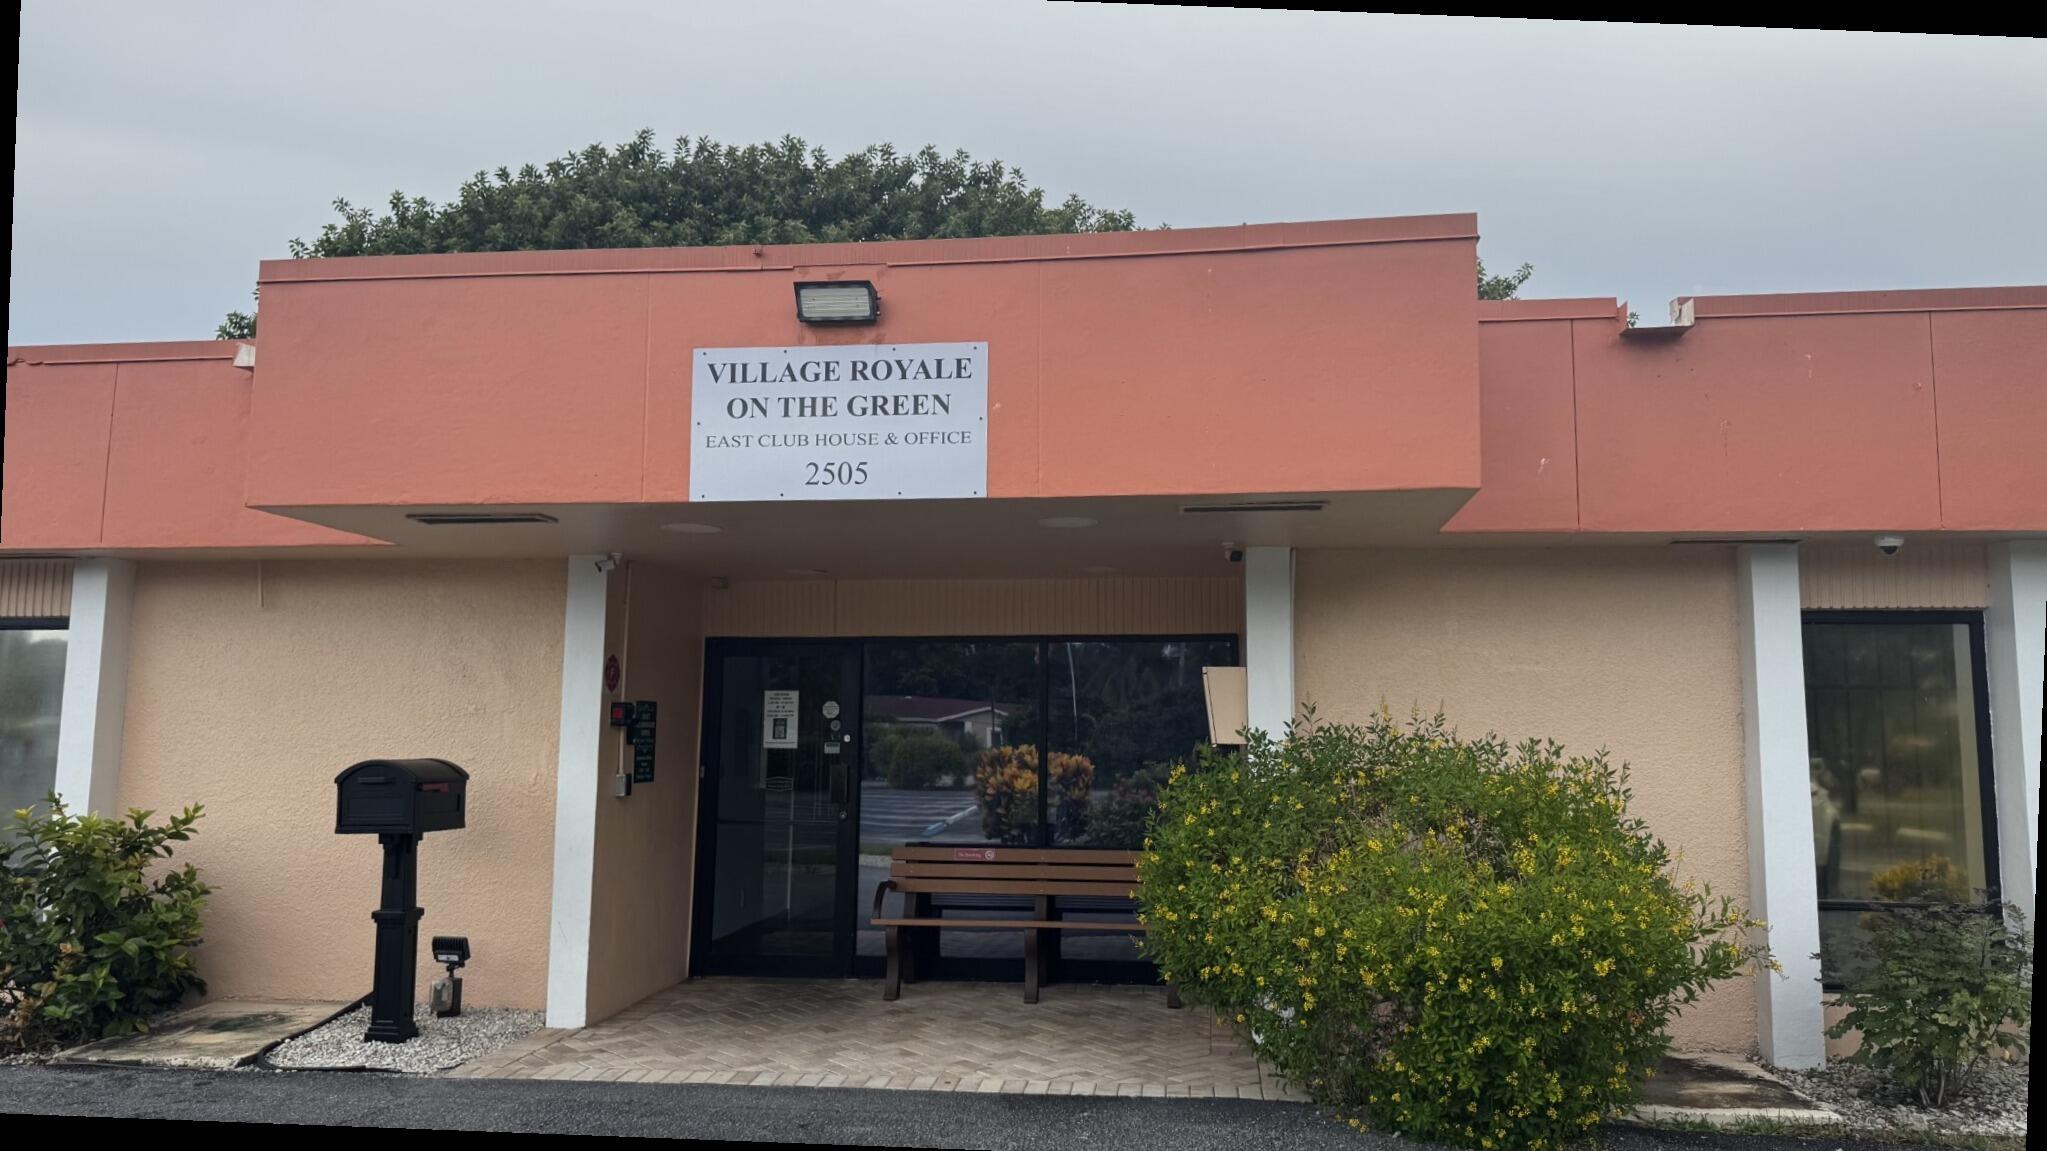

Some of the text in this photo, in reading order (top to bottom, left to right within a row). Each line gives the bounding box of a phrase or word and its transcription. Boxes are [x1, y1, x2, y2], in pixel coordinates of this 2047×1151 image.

[707, 357, 972, 383] VILLAGE ROYALE
[726, 393, 951, 418] ON THE GREEN
[704, 431, 971, 448] EAST CLUB HOUSE & OFFICE
[805, 461, 868, 485] 2505
